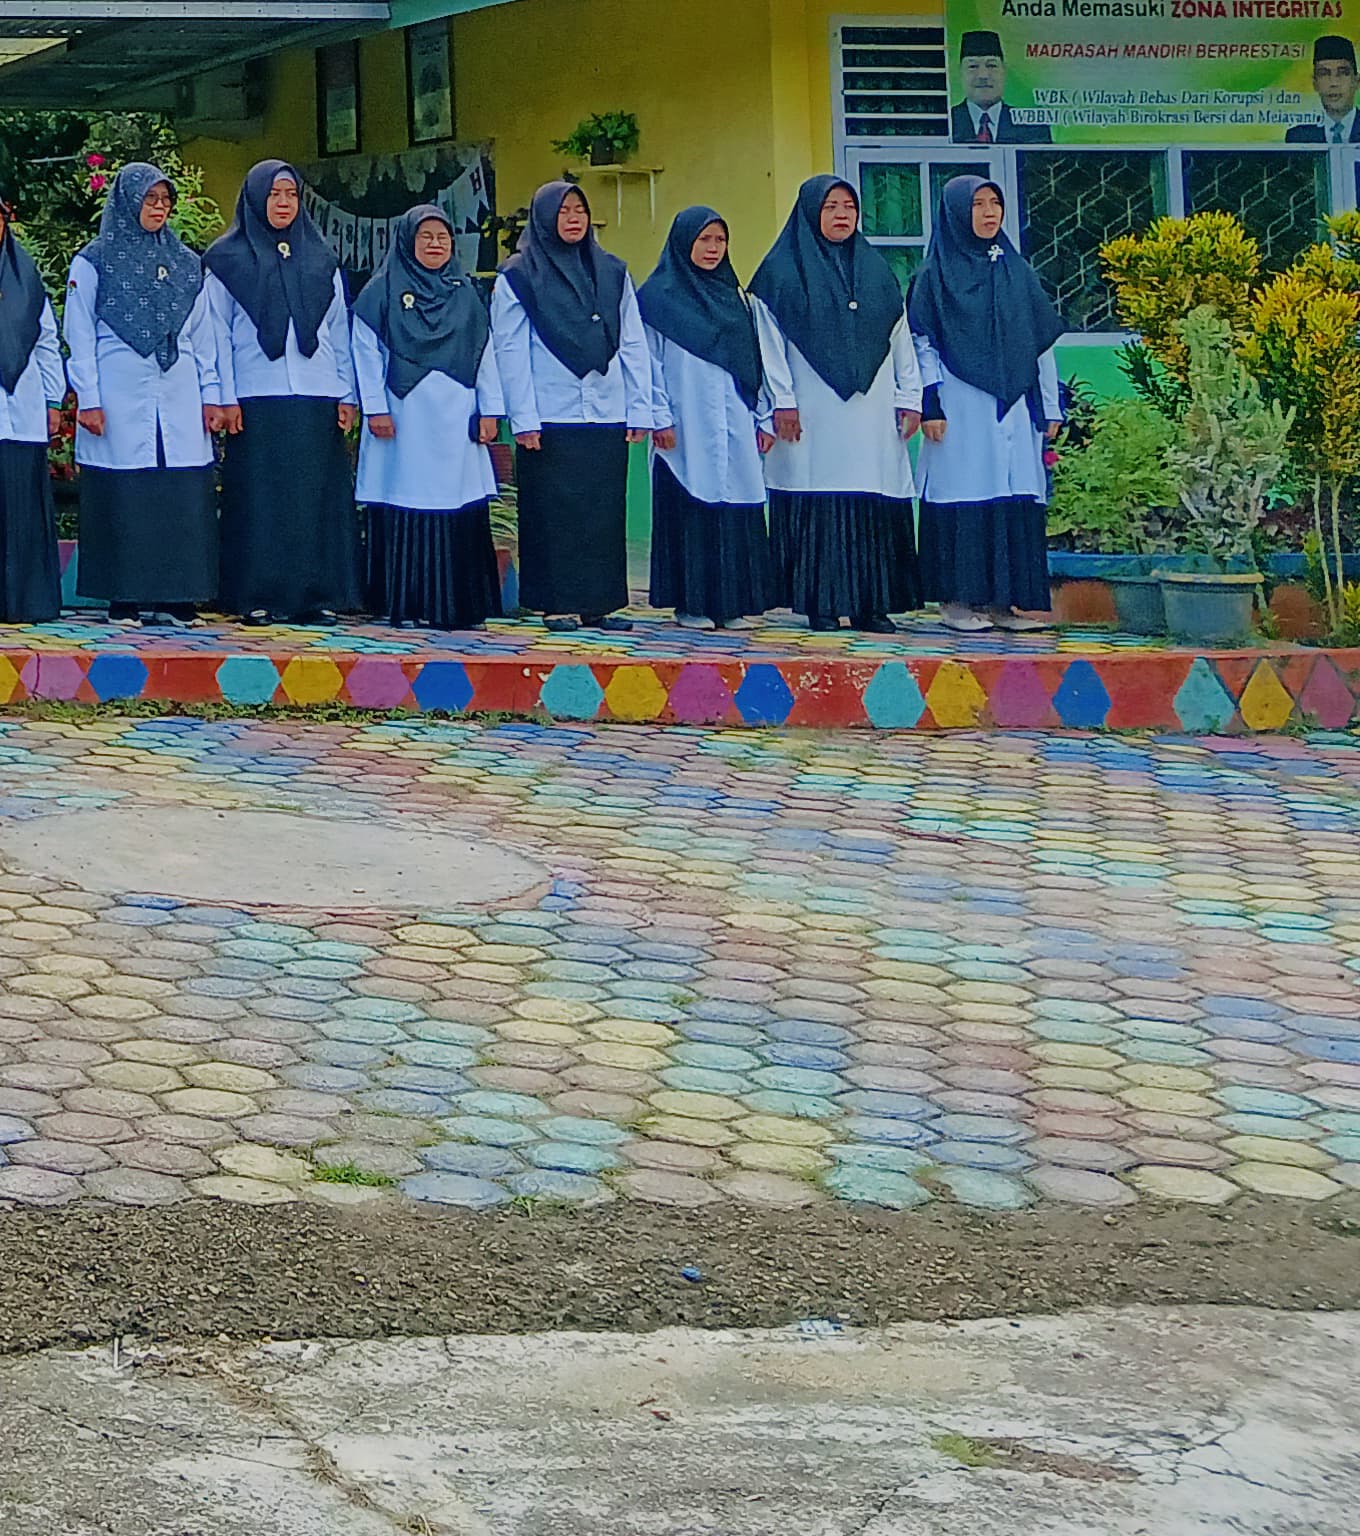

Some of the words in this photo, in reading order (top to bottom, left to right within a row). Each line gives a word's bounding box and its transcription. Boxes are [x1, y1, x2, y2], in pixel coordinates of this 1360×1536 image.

[1170, 0, 1228, 18] ZONA
[1232, 0, 1343, 18] INTEGRITAS
[1026, 43, 1119, 58] MADRASAH
[1123, 43, 1192, 58] MANDIRI
[1196, 43, 1305, 59] BERPRESTASI
[1034, 89, 1069, 104] WBK
[1082, 89, 1136, 107] Wilayah
[1139, 90, 1177, 104] Bebas
[1181, 90, 1209, 104] Dari
[1213, 89, 1264, 106] Korupsi
[1277, 89, 1301, 104] dan
[1010, 109, 1063, 125] WBBM
[1073, 109, 1126, 127] Wilayah
[1130, 109, 1189, 124] Birokrasi
[1194, 109, 1230, 123] Bersi
[1231, 109, 1255, 123] dan
